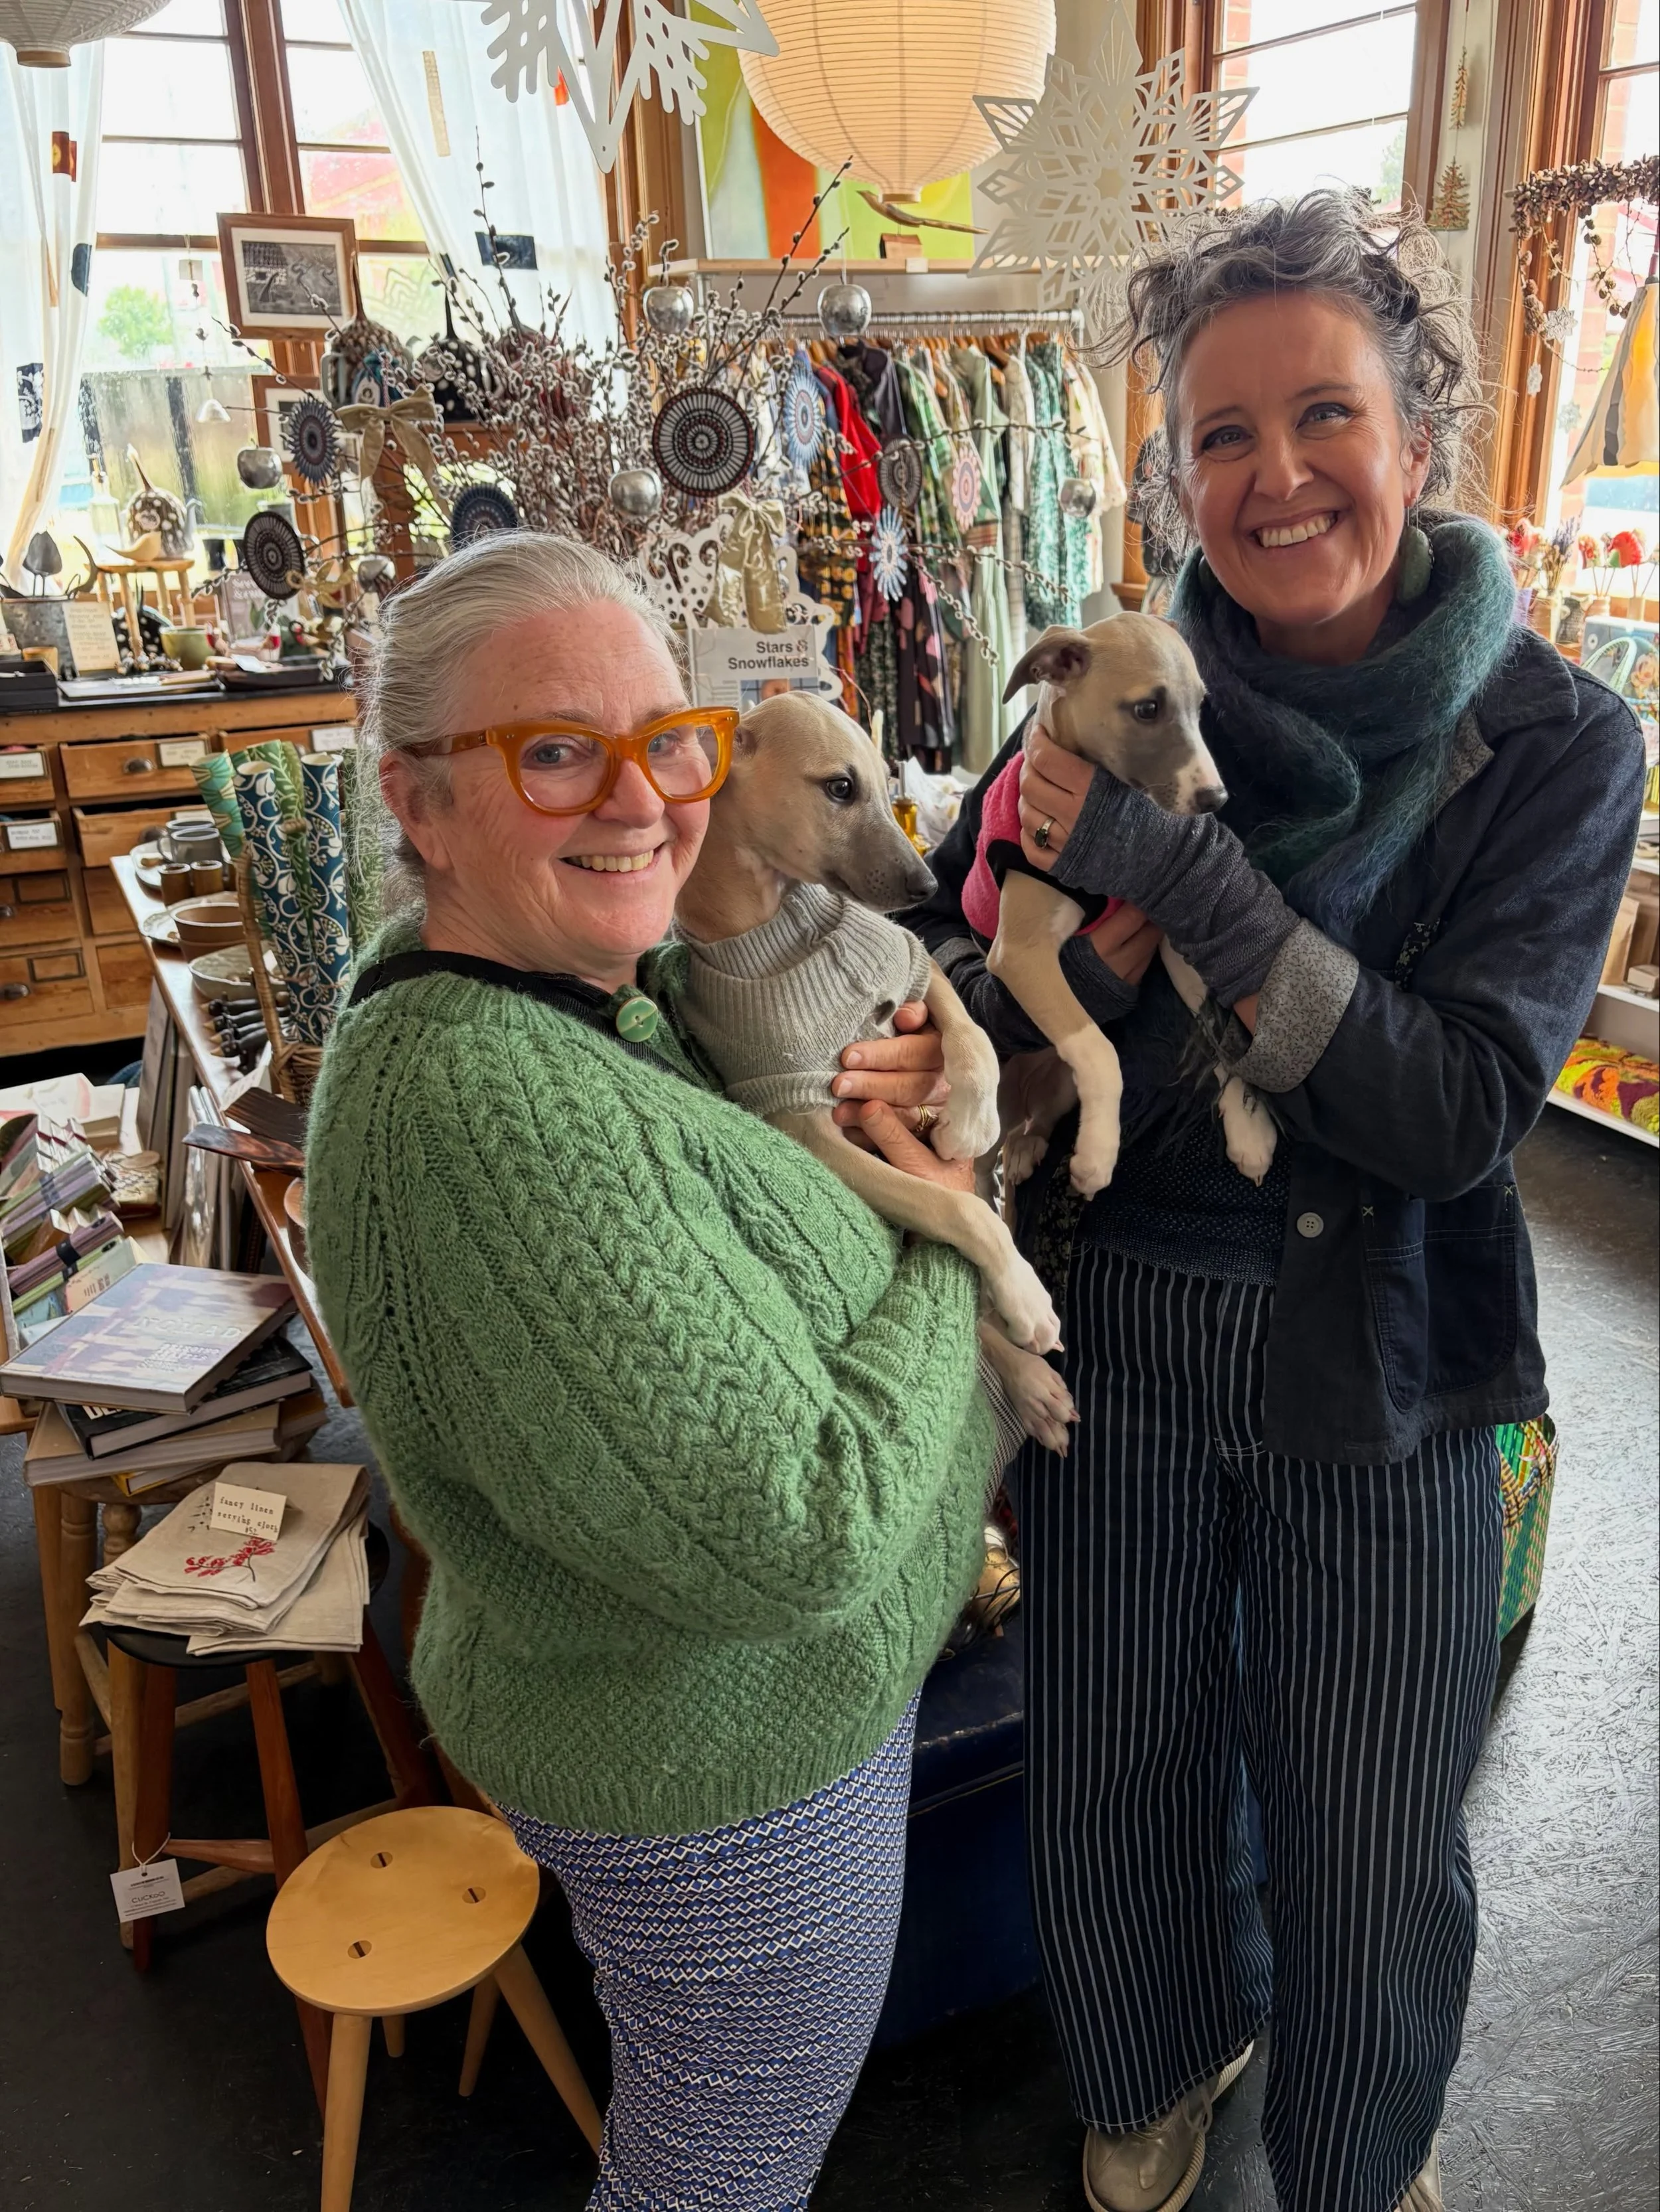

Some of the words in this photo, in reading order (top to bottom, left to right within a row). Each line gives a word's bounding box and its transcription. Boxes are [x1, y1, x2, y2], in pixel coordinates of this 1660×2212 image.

[756, 641, 793, 653] Stars
[797, 639, 808, 652] &
[728, 656, 809, 670] Snowflakes
[220, 1496, 244, 1509] fancy
[250, 1502, 274, 1514] linen
[218, 1512, 251, 1526] serving
[258, 1521, 278, 1533] cloth
[131, 1891, 165, 1903] CUCKOO
